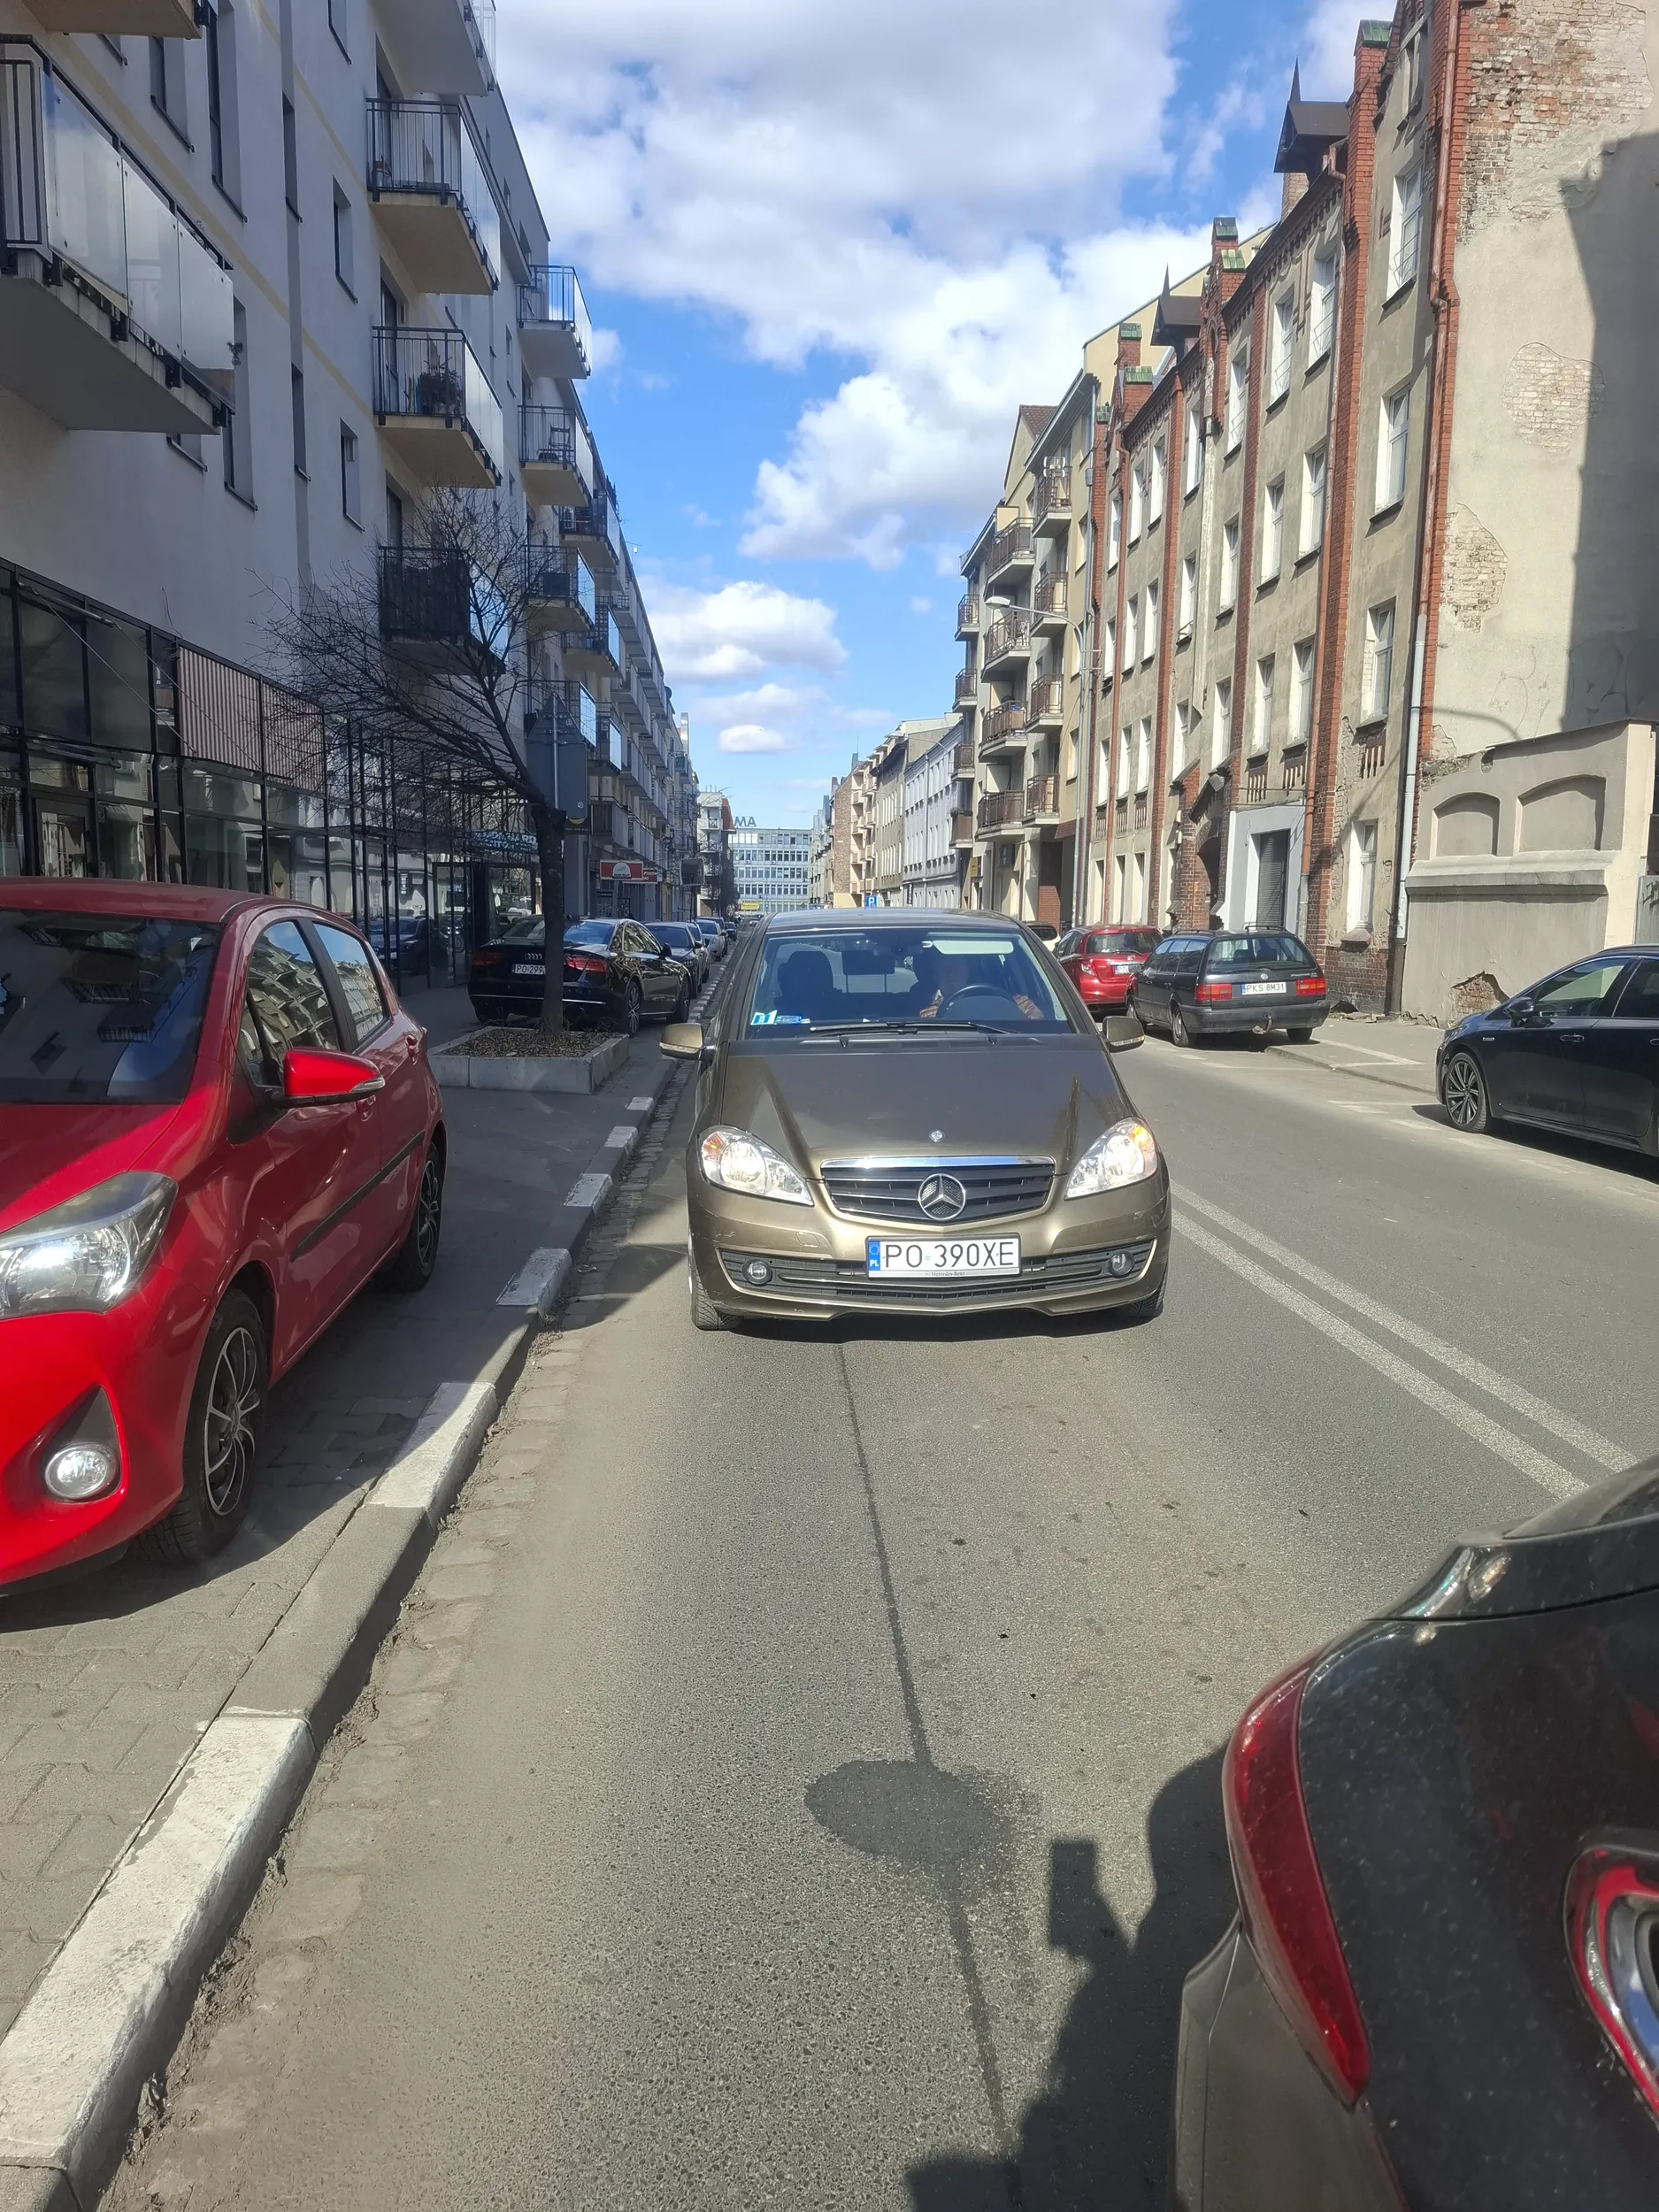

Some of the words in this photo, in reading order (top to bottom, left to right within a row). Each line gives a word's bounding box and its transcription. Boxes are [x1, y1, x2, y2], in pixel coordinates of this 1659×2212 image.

[516, 964, 527, 973] PO
[529, 965, 546, 974] 299
[1246, 984, 1264, 993] PKS
[885, 1244, 923, 1268] PO
[933, 1241, 1014, 1268] 390XE
